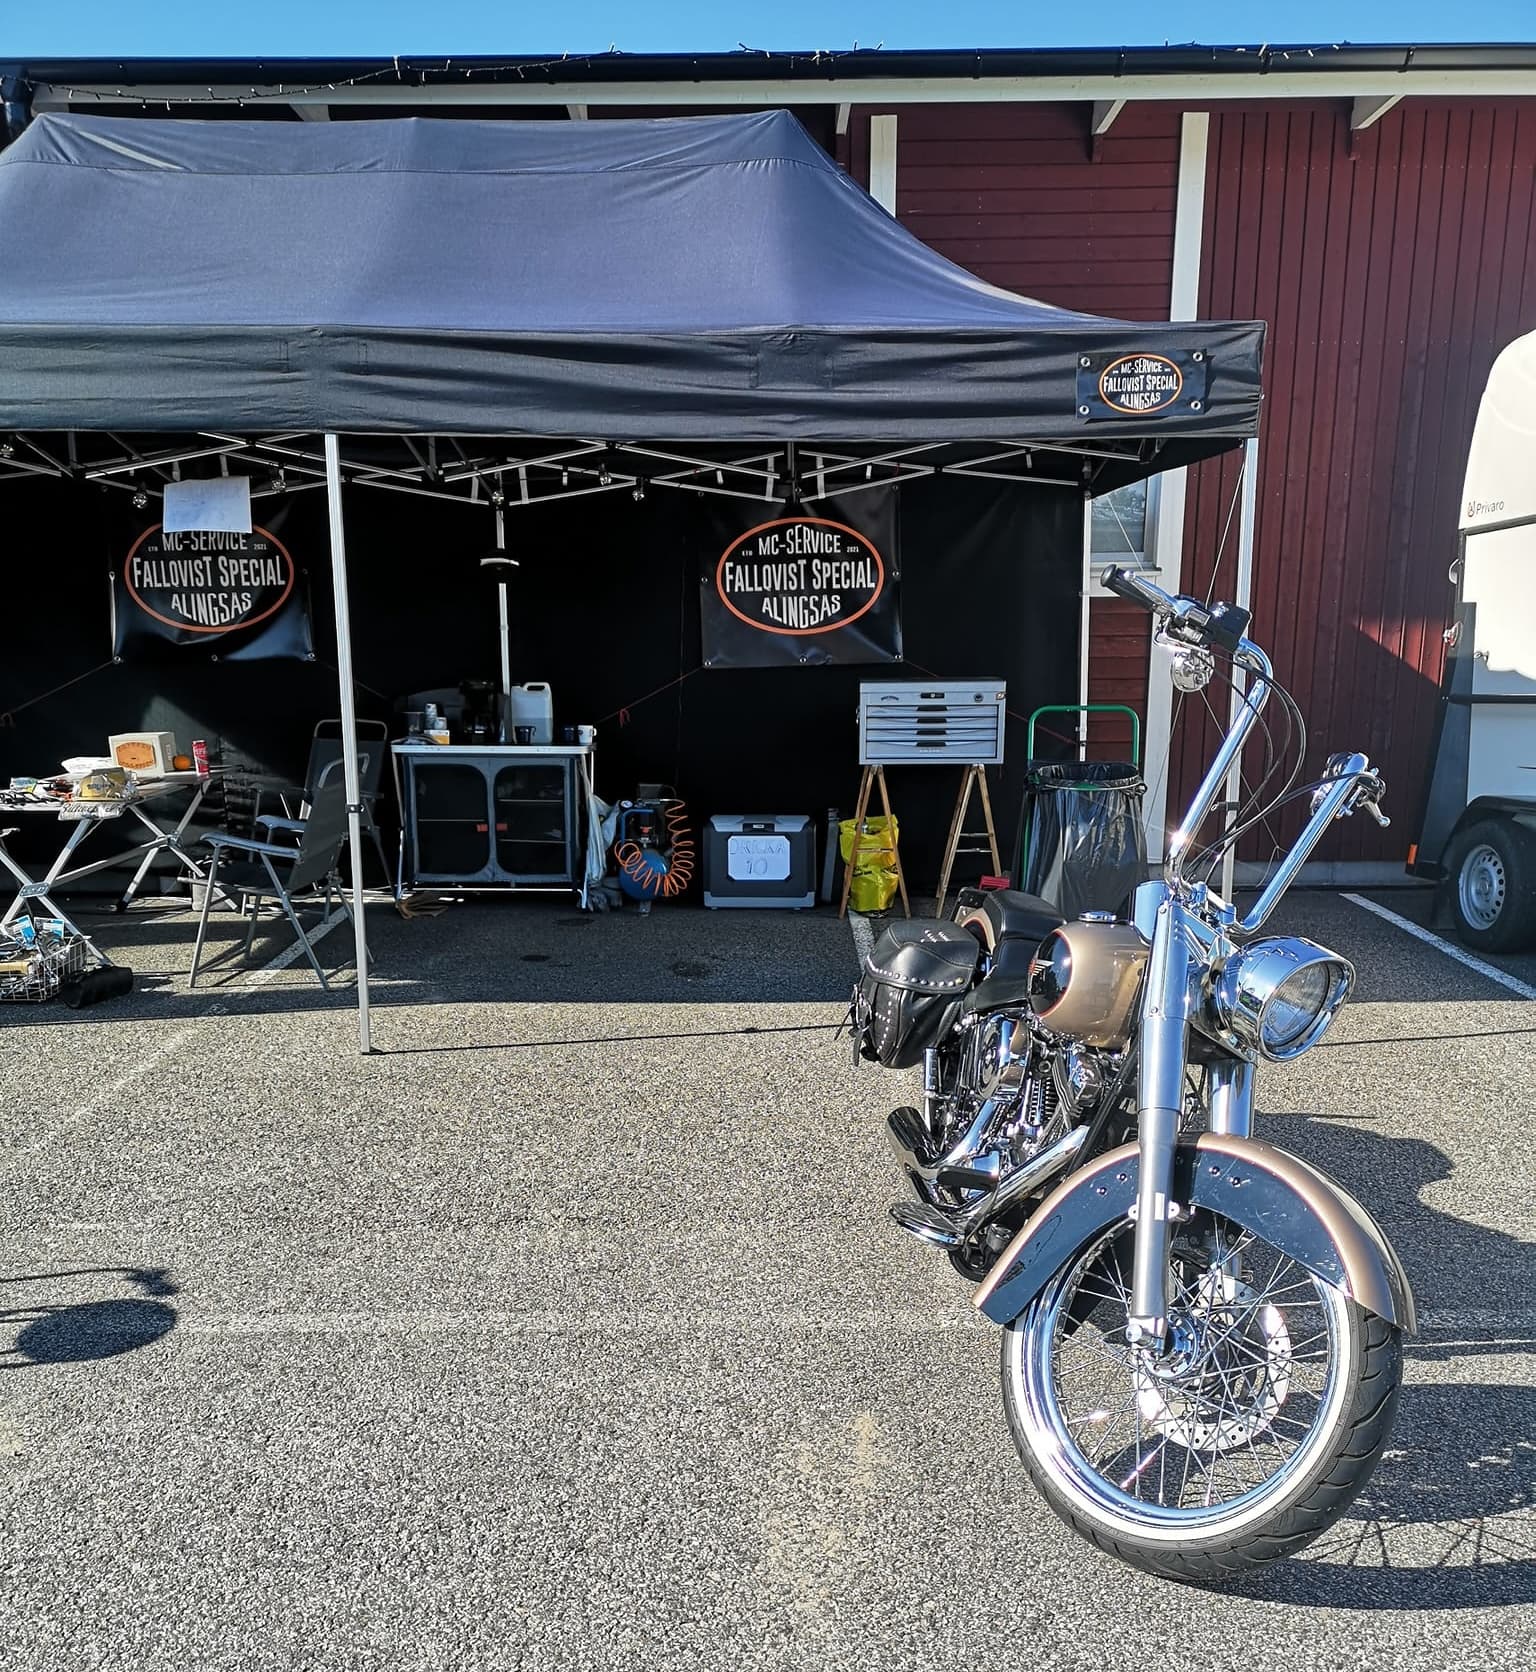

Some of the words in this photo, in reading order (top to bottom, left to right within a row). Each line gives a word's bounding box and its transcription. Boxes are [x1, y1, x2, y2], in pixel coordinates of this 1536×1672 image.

[1121, 357, 1162, 374] MC-SERVICE
[1146, 373, 1178, 390] SPECIAL
[162, 531, 248, 552] MC-SERVICE
[758, 524, 841, 556] MC-SERVICE
[846, 545, 859, 553] 2021
[132, 556, 212, 589] FALLQVIST
[218, 555, 286, 587] SPECIAL
[725, 559, 807, 593] FALLQVIST
[812, 557, 876, 590] SPECIAL
[171, 592, 252, 626] ALINGSAS
[761, 594, 841, 629] ALINGSAS
[746, 857, 768, 875] 10
